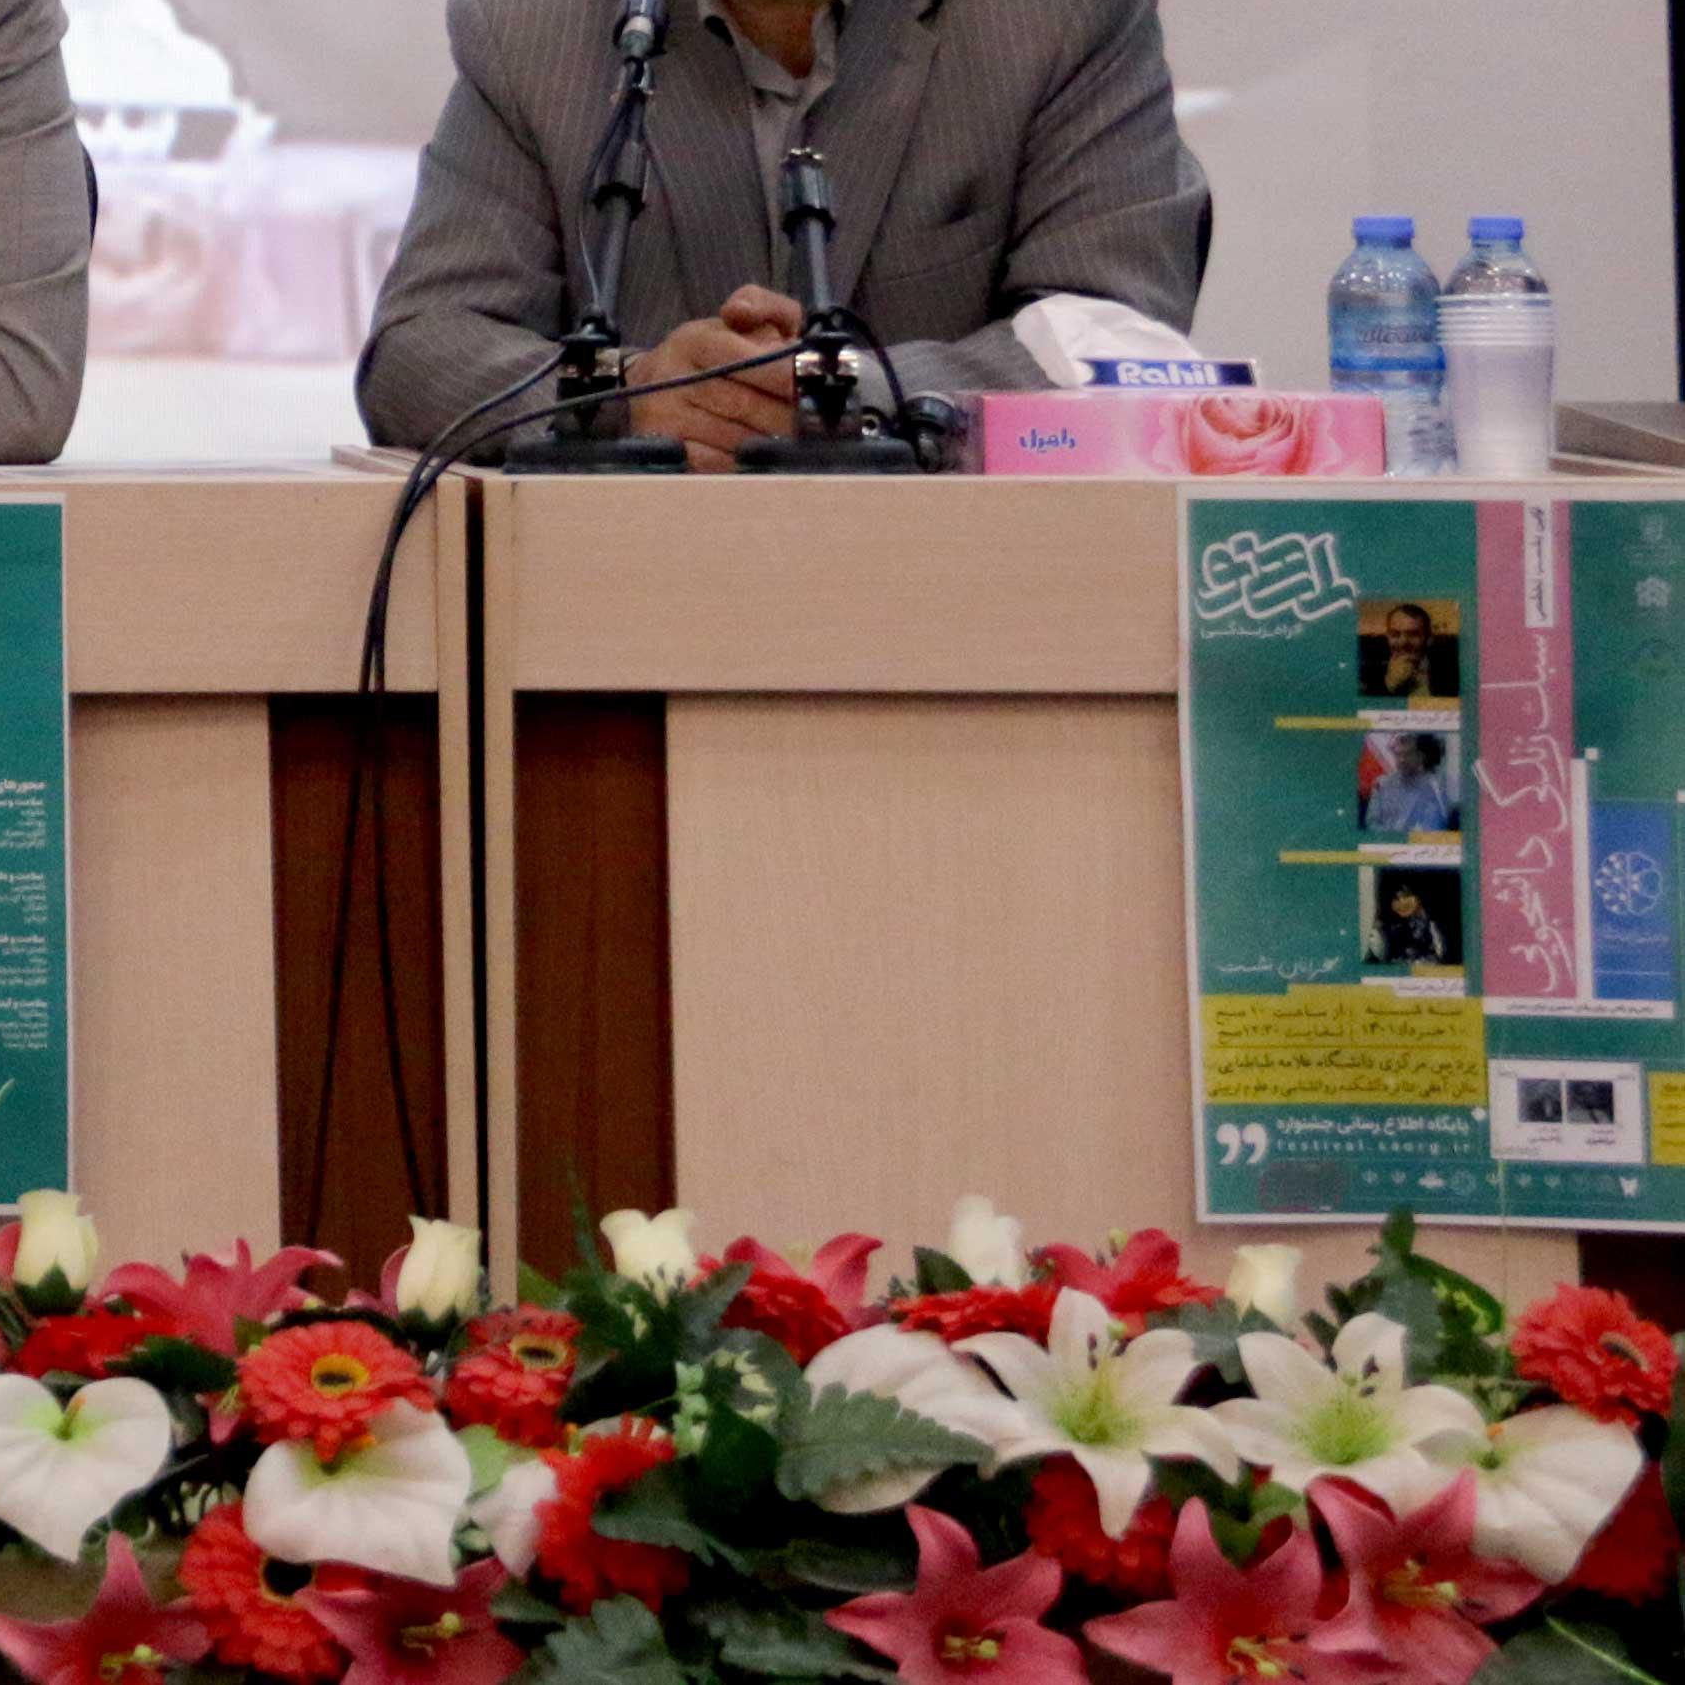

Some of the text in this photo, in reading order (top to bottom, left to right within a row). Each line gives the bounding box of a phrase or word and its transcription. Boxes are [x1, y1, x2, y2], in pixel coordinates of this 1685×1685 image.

[1116, 361, 1218, 385] Rahil
[1472, 734, 1568, 833] زندگی
[1492, 835, 1575, 993] دانشجویی
[1383, 1117, 1424, 1135] اطلاع
